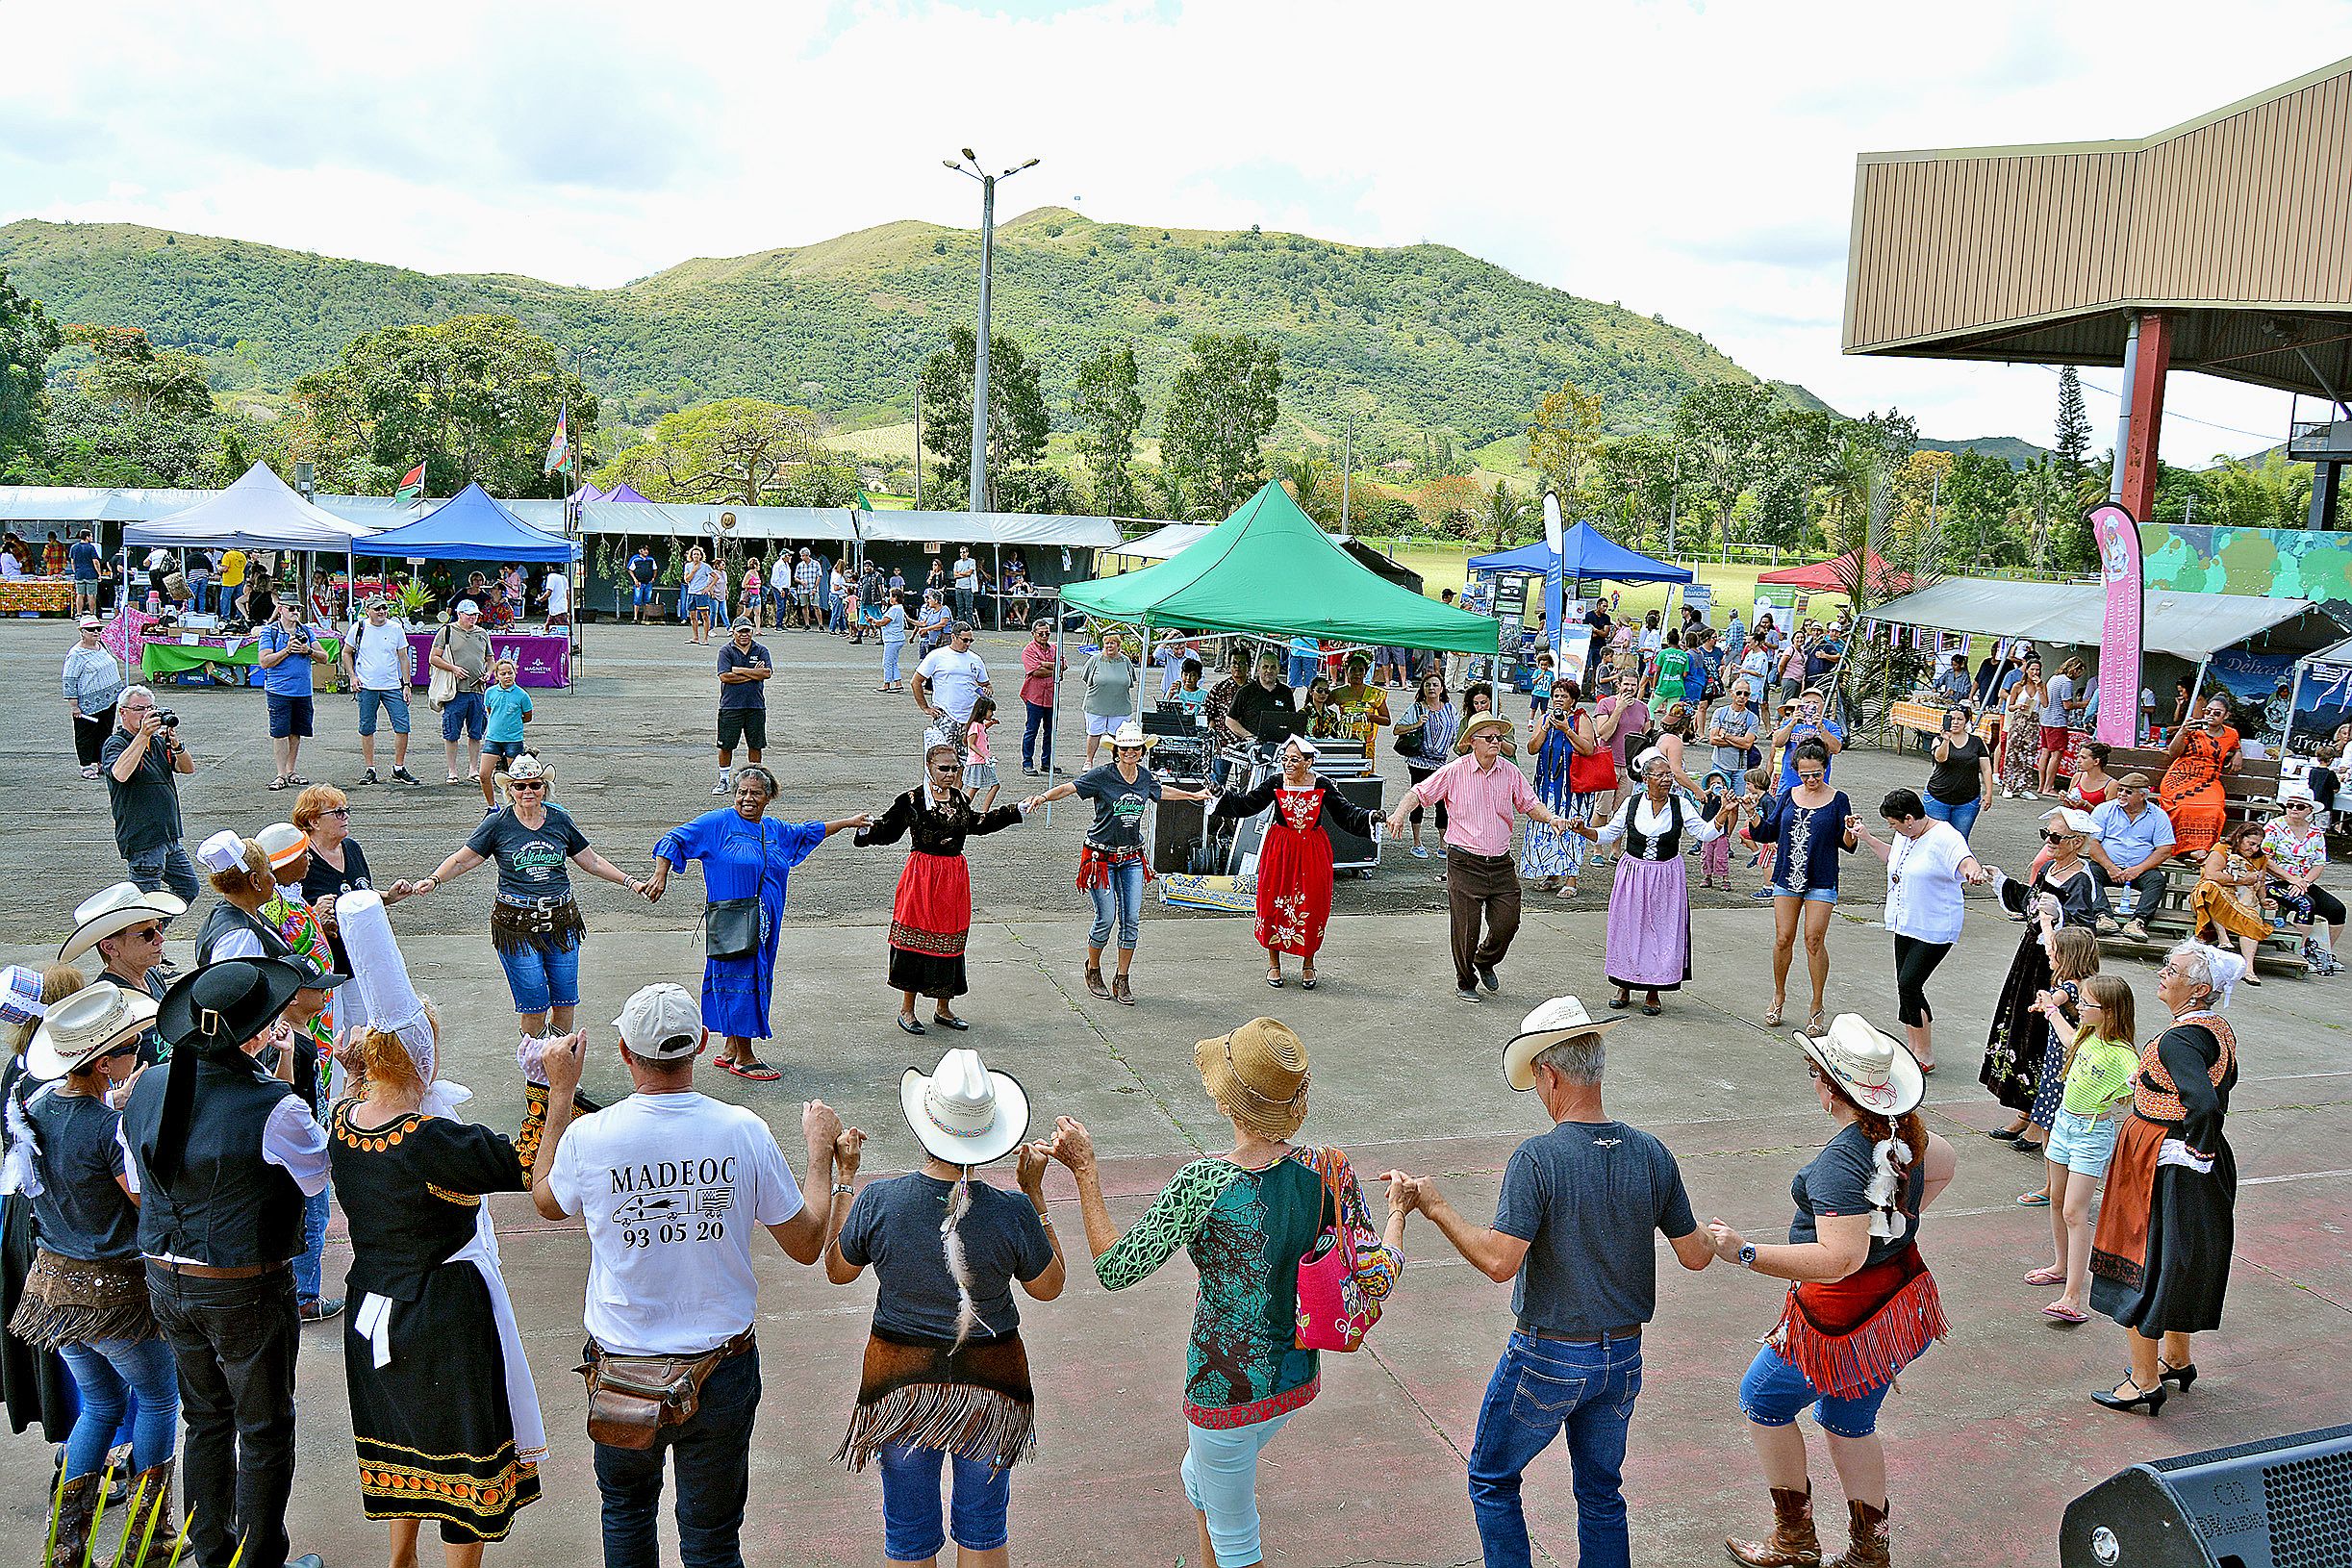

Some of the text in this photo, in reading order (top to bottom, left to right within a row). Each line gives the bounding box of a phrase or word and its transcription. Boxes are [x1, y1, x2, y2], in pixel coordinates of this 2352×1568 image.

[2224, 657, 2281, 675] Délices
[610, 1156, 736, 1194] MADEOC
[623, 1221, 724, 1249] 93 05 20
[2213, 1480, 2251, 1505] C12
